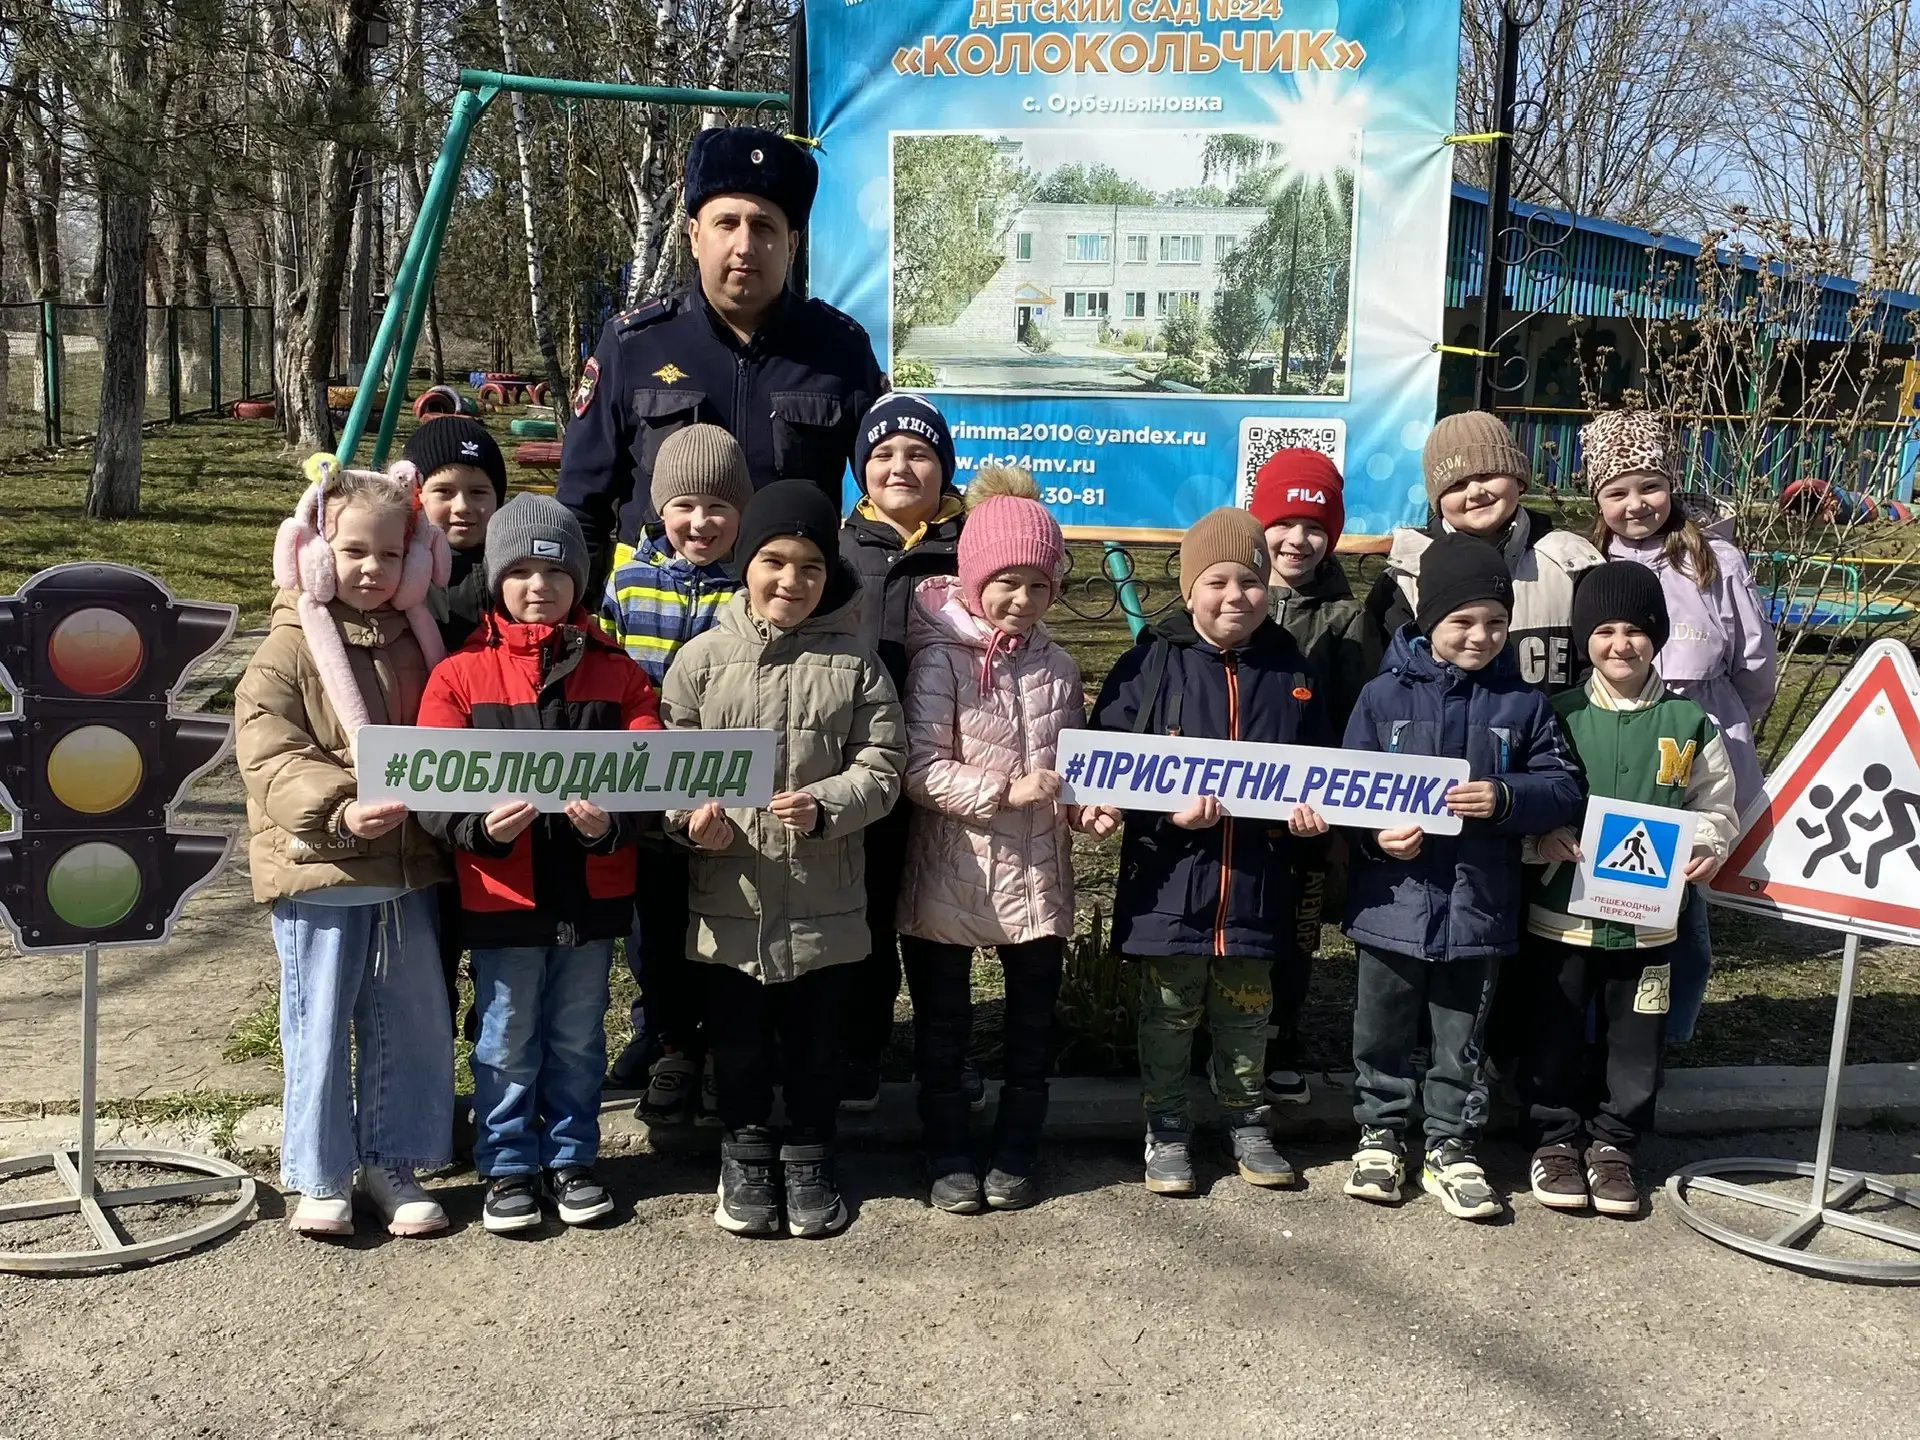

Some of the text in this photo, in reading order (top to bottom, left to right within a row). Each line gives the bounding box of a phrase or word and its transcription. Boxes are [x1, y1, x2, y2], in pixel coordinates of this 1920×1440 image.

[971, 0, 1282, 27] ДЕТСКИЙ САД №24
[891, 30, 1368, 77] «КОЛОКОЛЬЧИК»
[1022, 91, 1222, 115] с. Орбельяновка
[867, 416, 940, 445] OFF WHITE
[950, 422, 1206, 448] rimma2010@yandex.ru
[1286, 488, 1327, 504] FILA
[384, 741, 753, 800] #СОБЛЮДАЙ_ПДД
[1656, 737, 1698, 787] M
[1065, 750, 1460, 817] #ПРИСТЕГНИ_РЕБЕНКА
